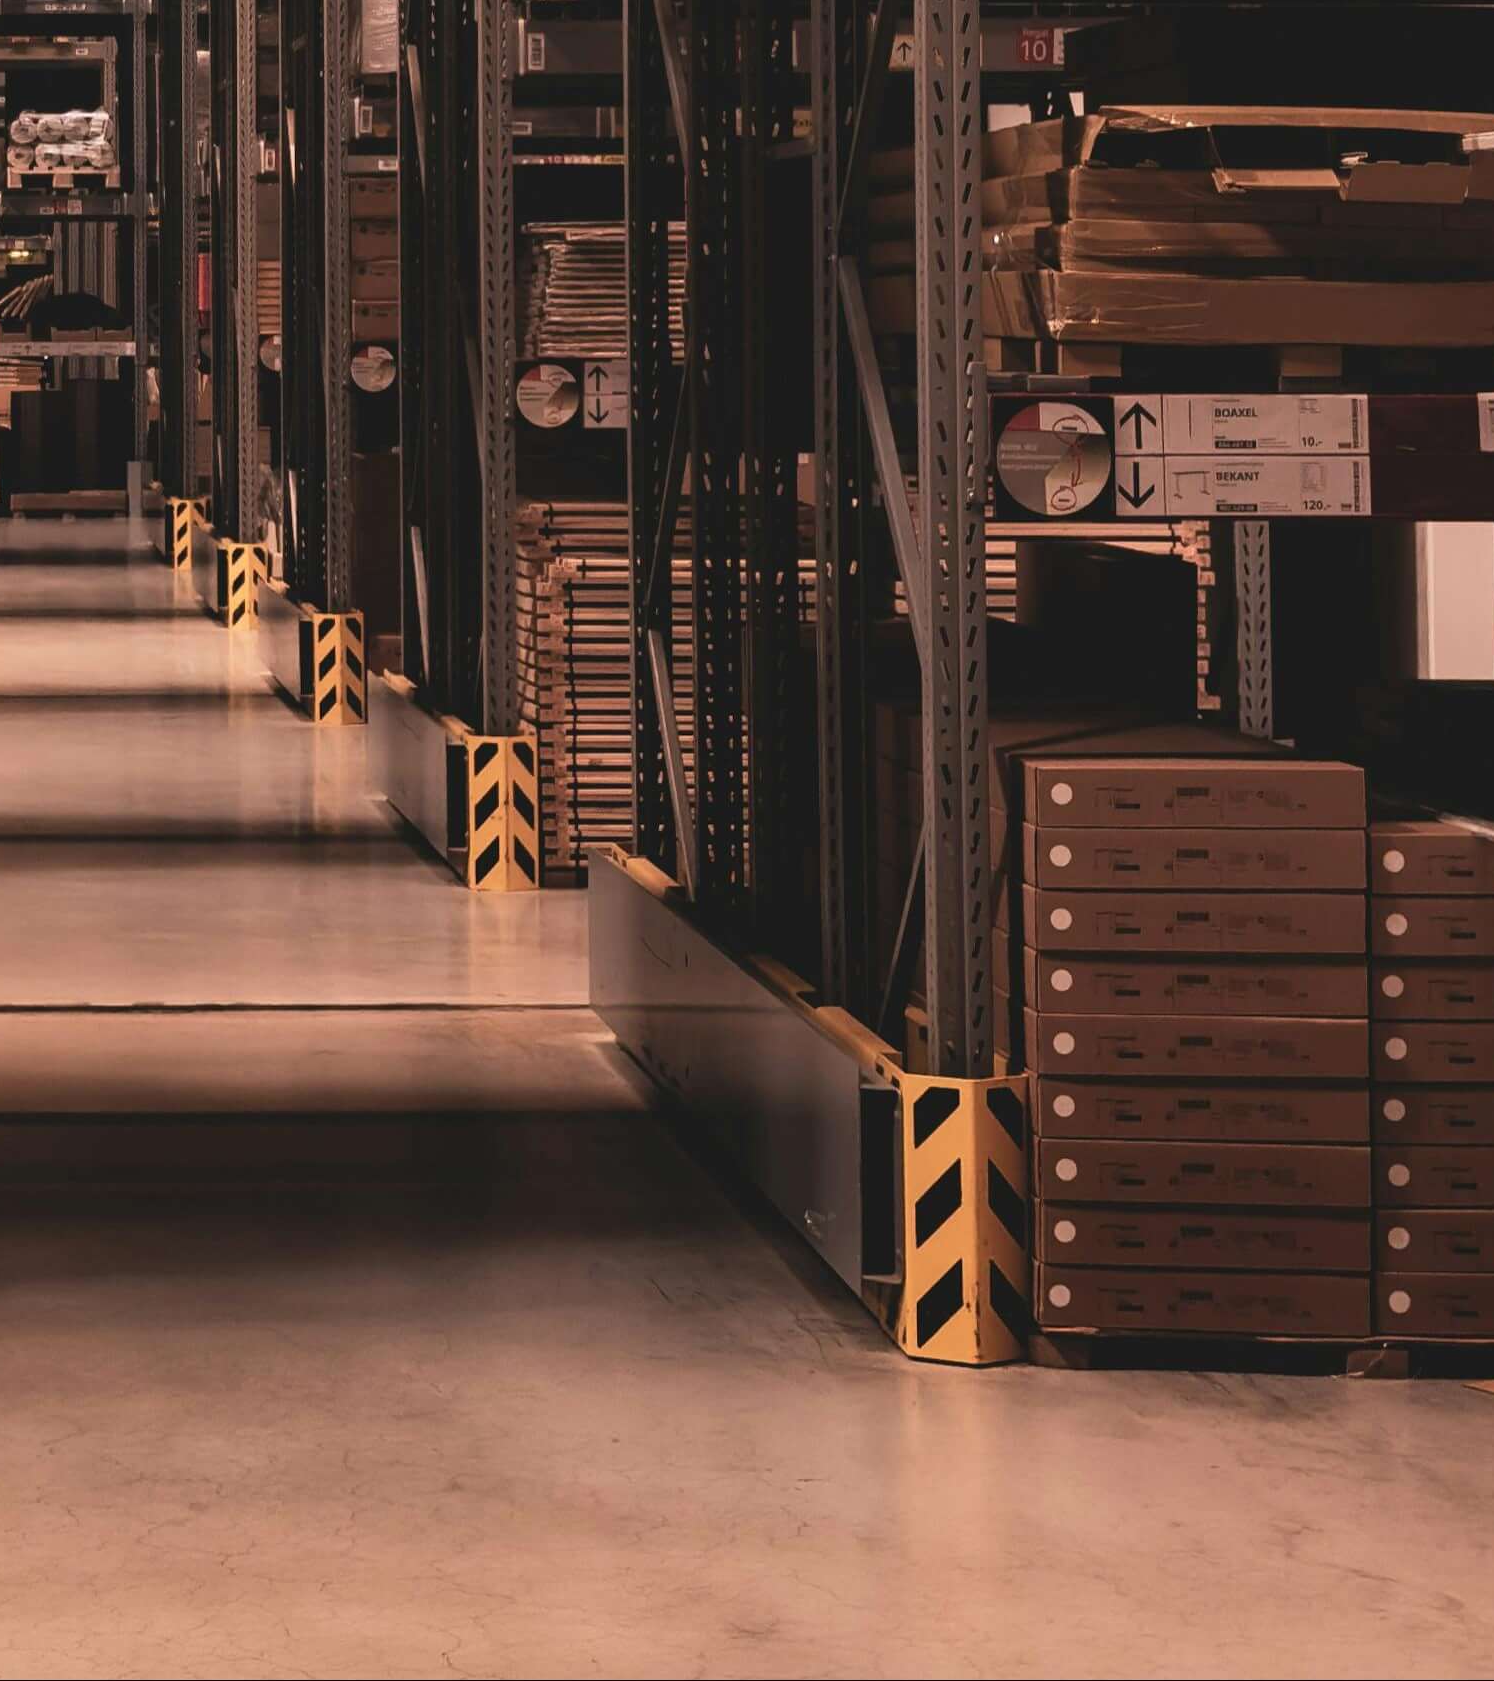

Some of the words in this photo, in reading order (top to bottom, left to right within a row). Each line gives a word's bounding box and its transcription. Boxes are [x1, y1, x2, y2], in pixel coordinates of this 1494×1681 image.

[1023, 40, 1047, 61] 10
[1214, 407, 1258, 417] BOAXEL
[1303, 437, 1324, 447] 10.-
[1216, 471, 1260, 481] BEKANT
[1303, 500, 1333, 510] 120.-
